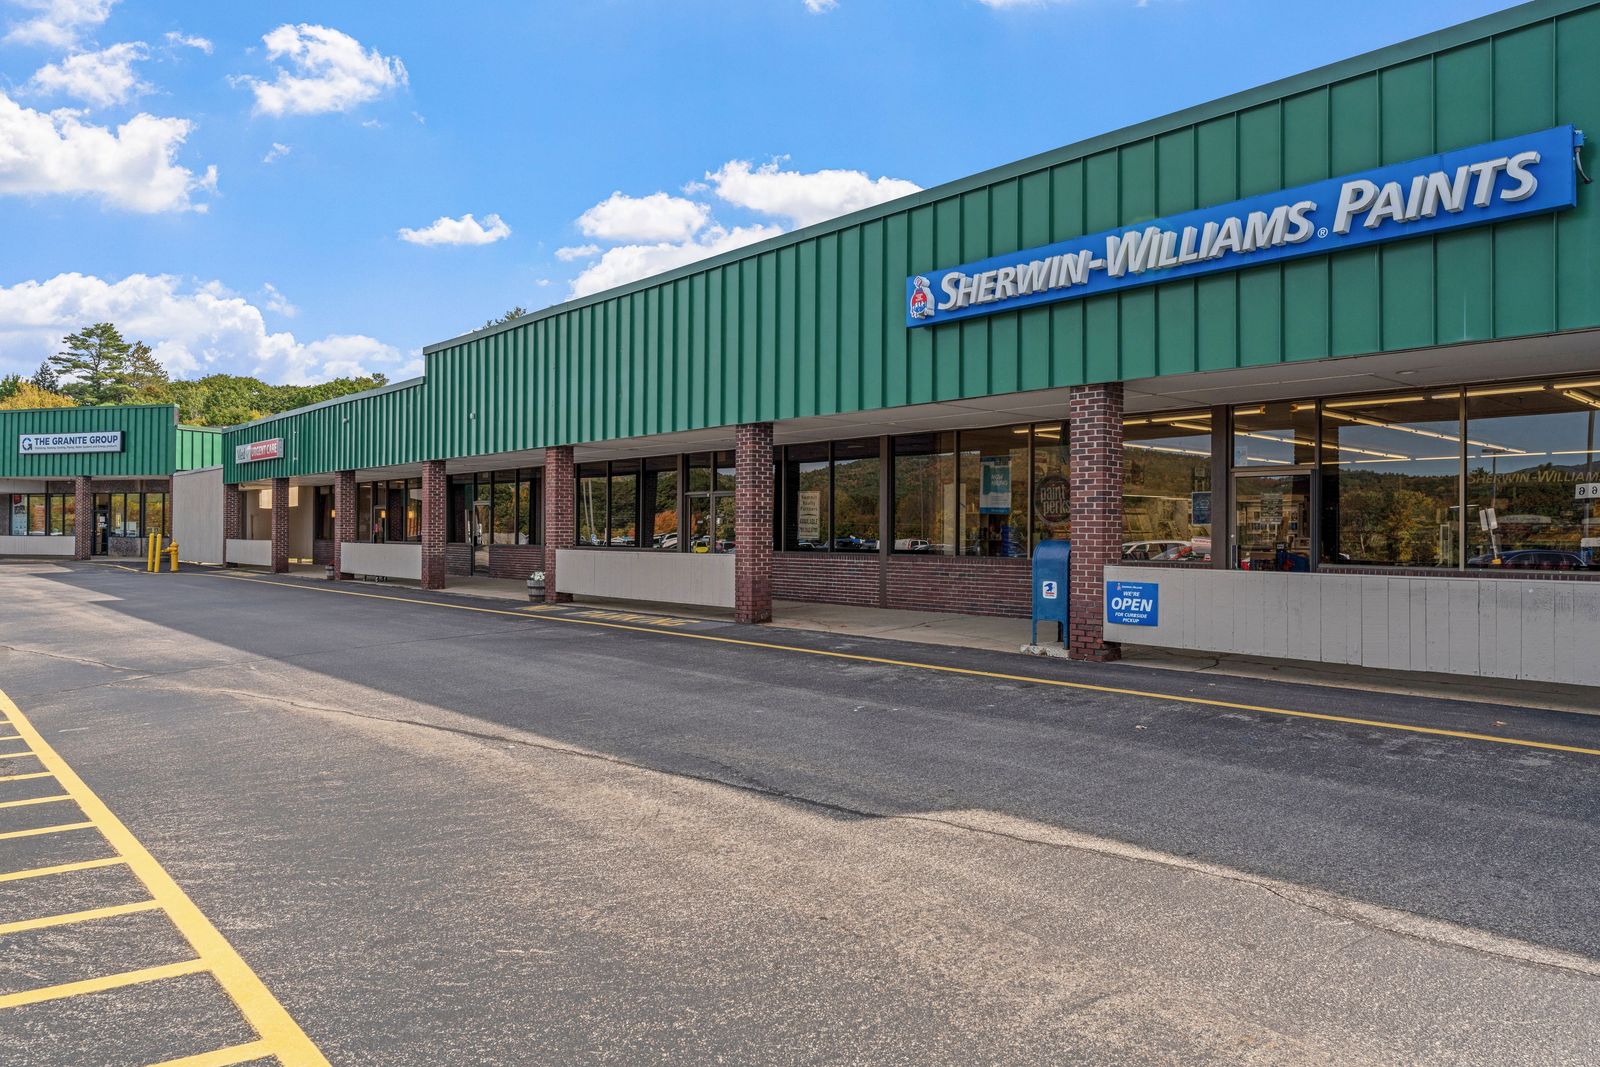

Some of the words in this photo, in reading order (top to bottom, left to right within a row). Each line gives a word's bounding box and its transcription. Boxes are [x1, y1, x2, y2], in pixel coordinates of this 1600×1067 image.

[938, 200, 1317, 311] SHERWIN-WILLIAMS
[1332, 151, 1541, 235] PAINTS
[34, 437, 50, 446] THE
[52, 436, 87, 445] GRANITE
[90, 435, 118, 444] GROUP
[1468, 470, 1600, 484] SHERWIN-WILLIAM
[1041, 484, 1066, 502] paint
[1043, 499, 1070, 517] perks
[1111, 597, 1153, 612] OPEN
